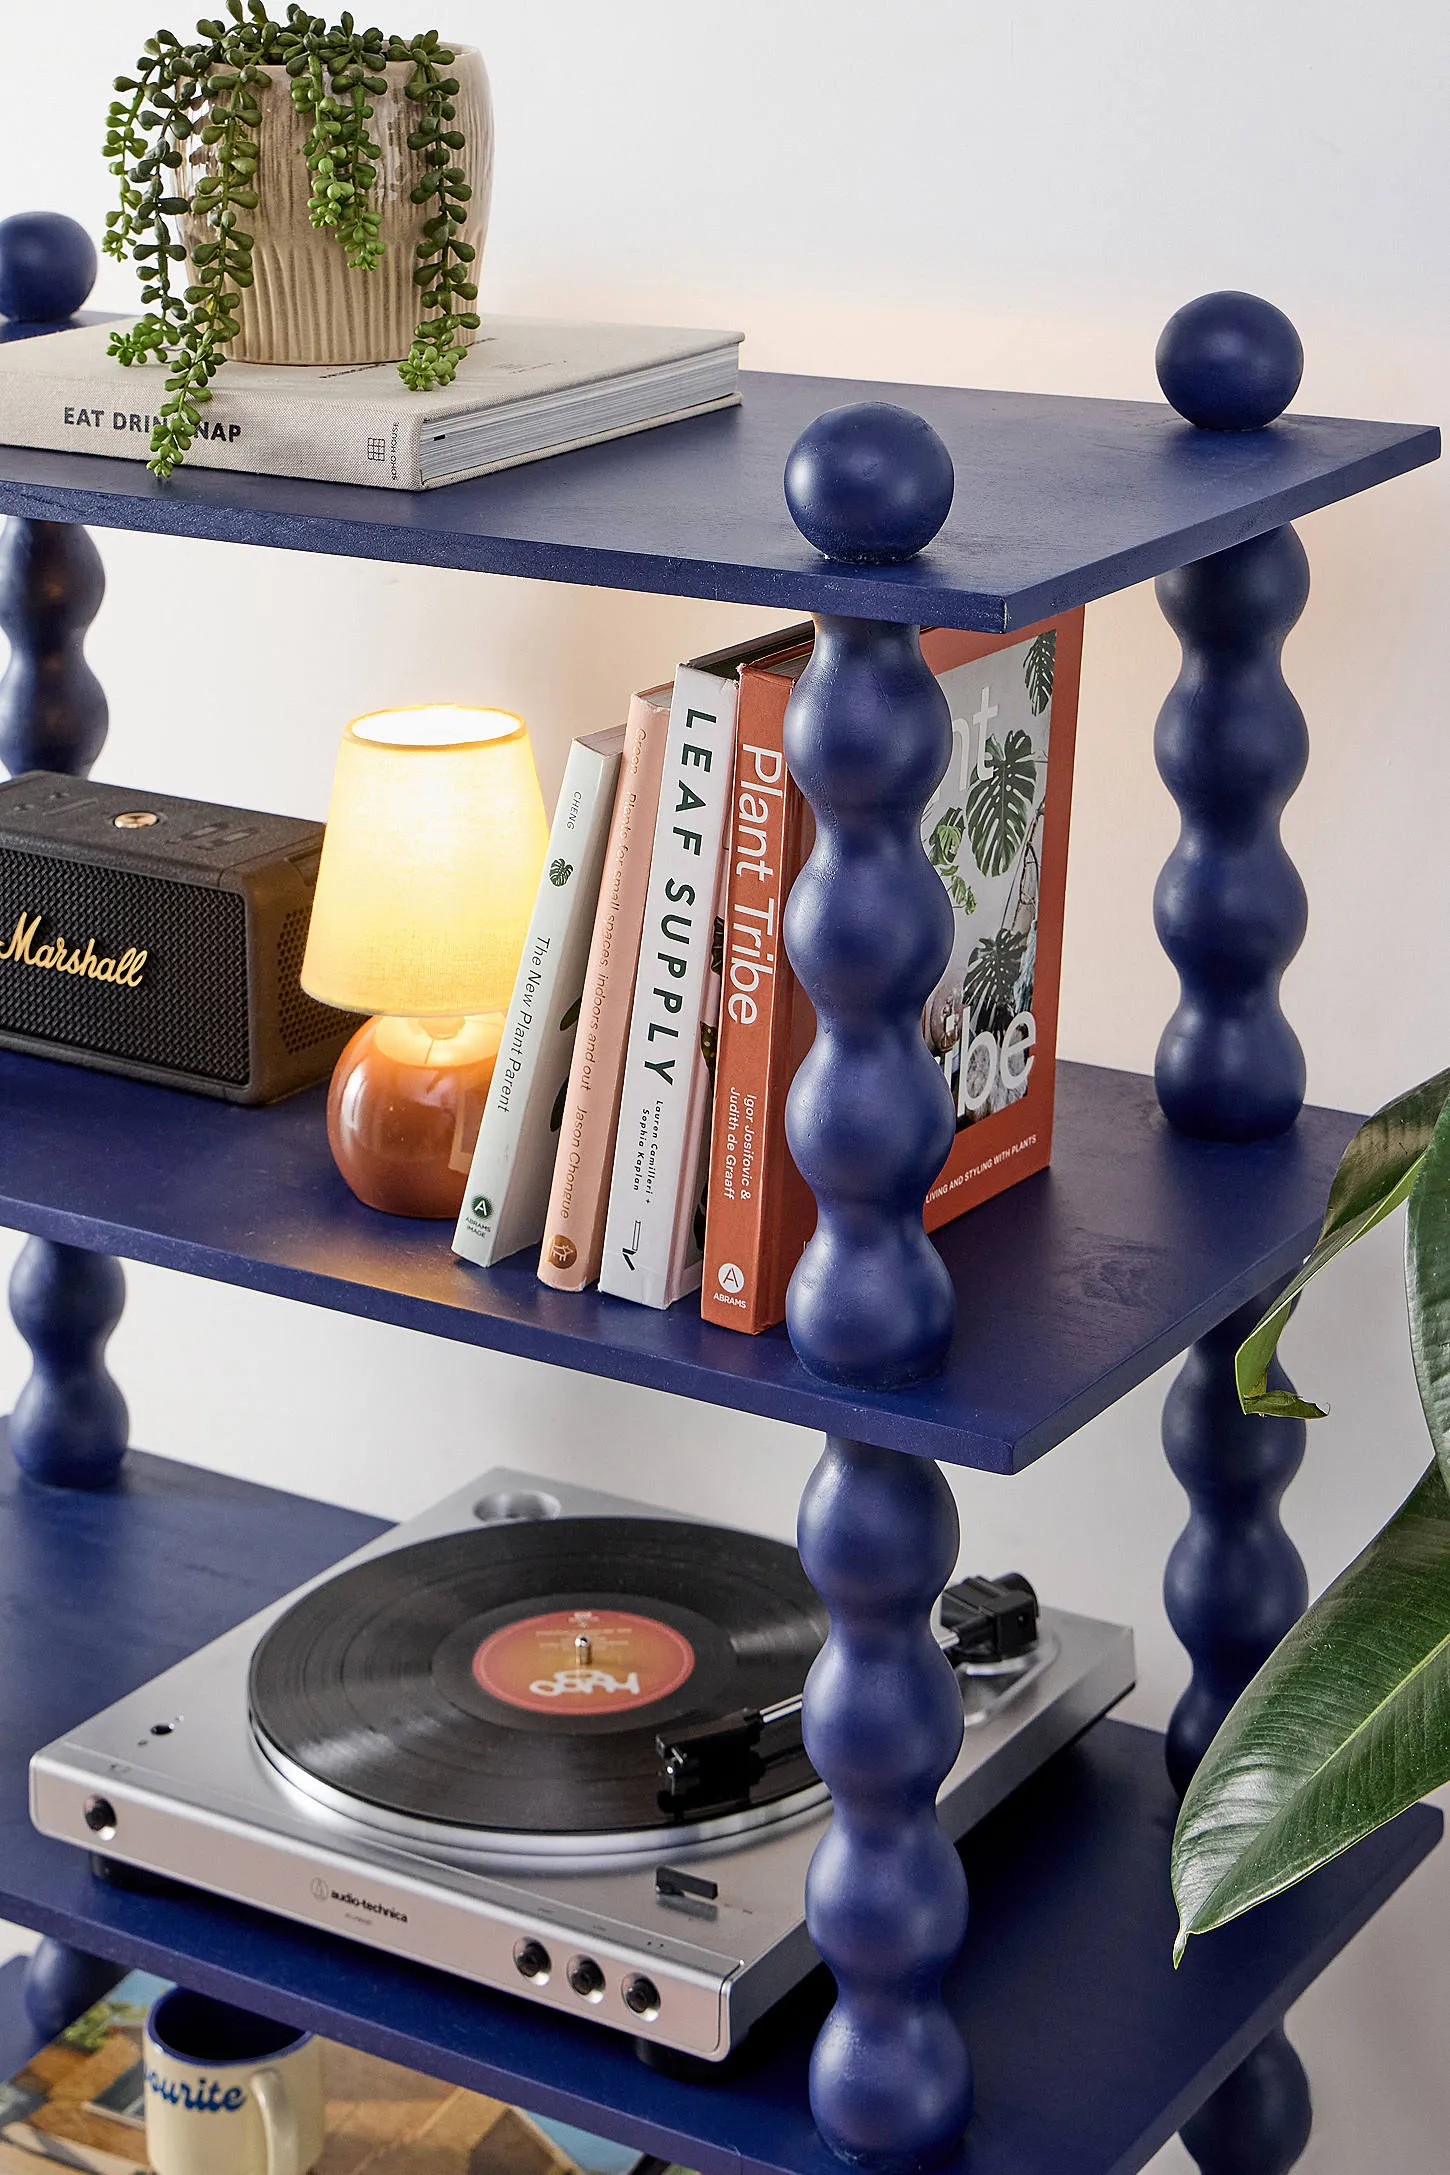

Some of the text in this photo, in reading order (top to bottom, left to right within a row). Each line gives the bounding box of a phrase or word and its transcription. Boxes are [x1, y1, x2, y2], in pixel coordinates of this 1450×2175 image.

[64, 407, 242, 443] EAT DRIN NAP
[390, 422, 400, 480] SOHO HOUSE
[630, 728, 647, 774] Green
[566, 791, 582, 830] CHENG
[619, 791, 637, 839] Plants
[616, 844, 629, 867] for
[609, 871, 623, 911] small
[644, 708, 717, 1086] LEAF SUPPLY
[728, 744, 783, 1025] Plant Tribe
[0, 911, 148, 987] Marshall
[498, 937, 551, 1113] The New Plant Parent
[590, 974, 609, 1030] indoors
[585, 1034, 597, 1065] and
[580, 1065, 592, 1091] out
[652, 1100, 664, 1139] Lauren
[723, 1086, 741, 1200] Judith de Graaff
[560, 1106, 587, 1219] Jason Chongue
[633, 1108, 650, 1191] Sophia Kaplan
[645, 1143, 659, 1195] Camilleri
[740, 1094, 757, 1200] Igor Josifovic &
[925, 1134, 1037, 1204] LIVING AND STYLING WITH PLANTS
[465, 1217, 491, 1233] ABRAMS
[467, 1225, 486, 1238] IMAGE
[713, 1293, 746, 1309] ABRAMS
[331, 1889, 408, 1923] audio-technica
